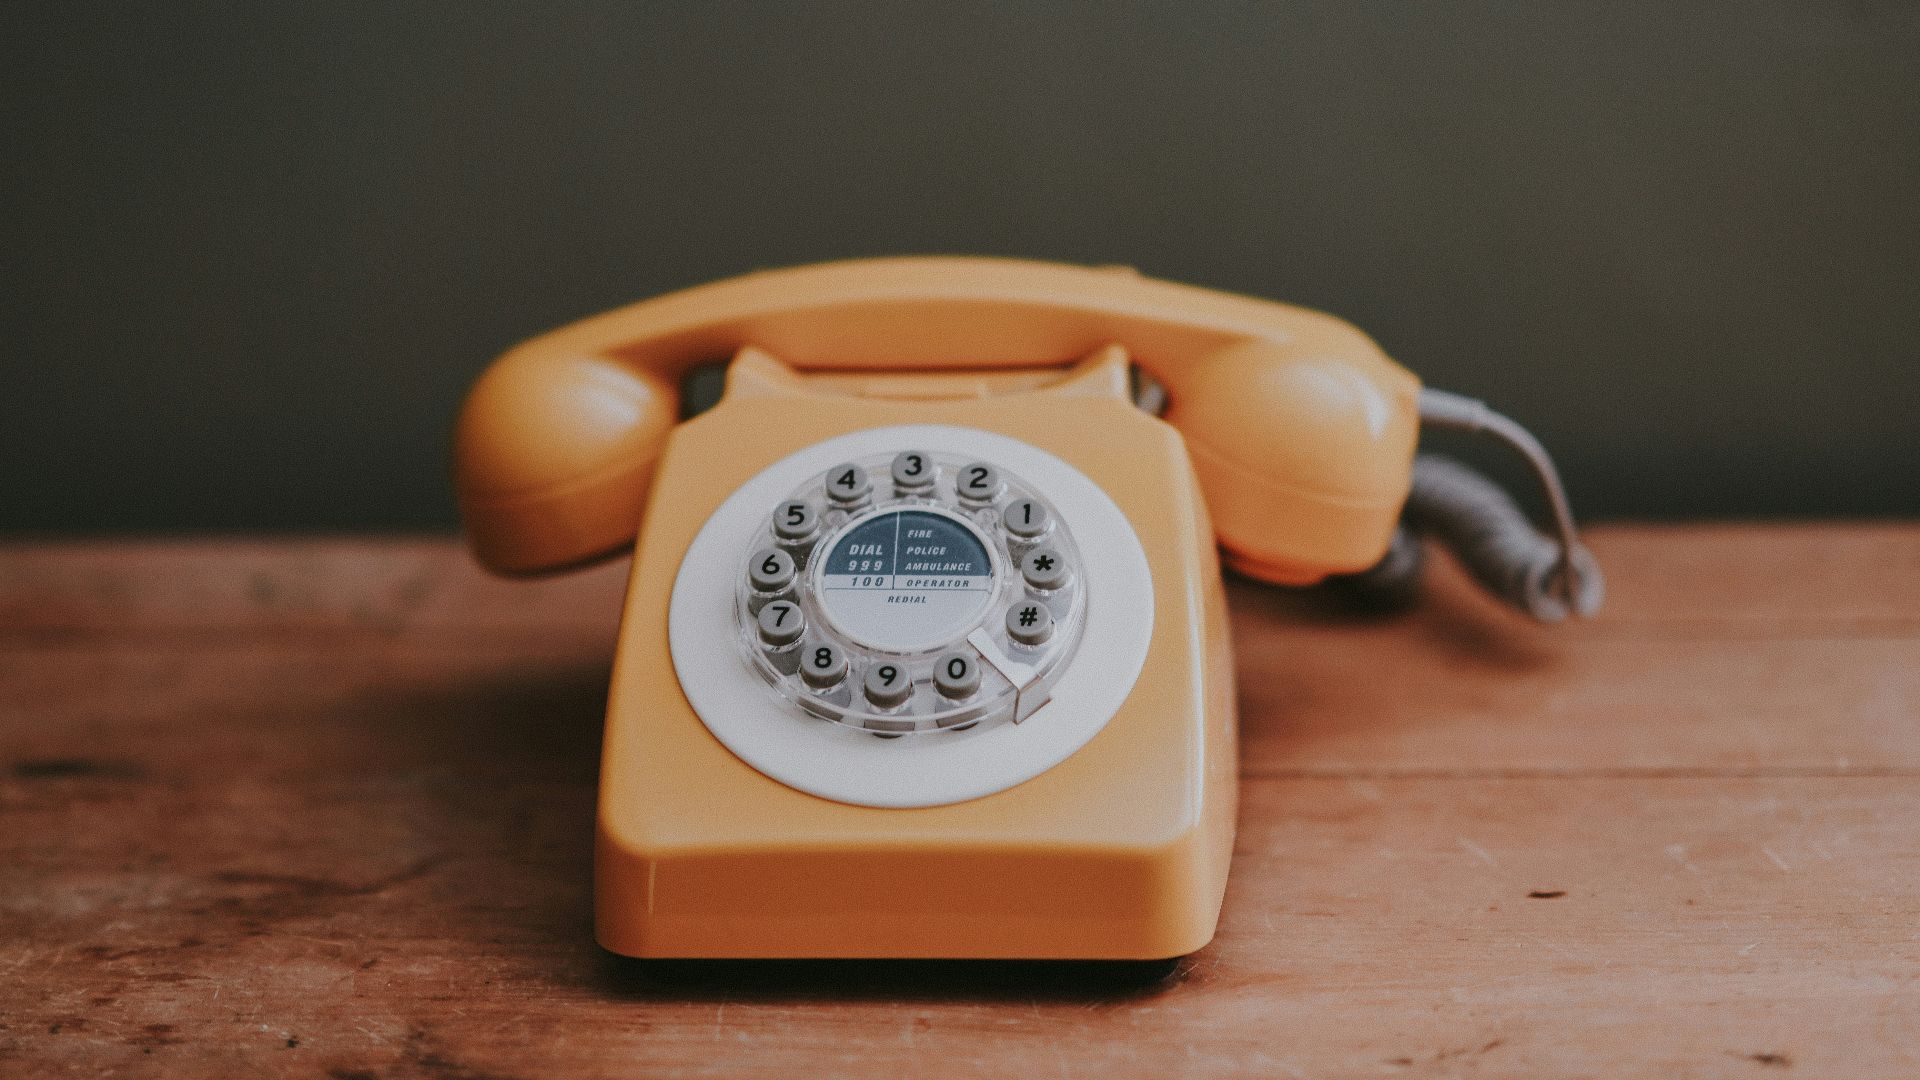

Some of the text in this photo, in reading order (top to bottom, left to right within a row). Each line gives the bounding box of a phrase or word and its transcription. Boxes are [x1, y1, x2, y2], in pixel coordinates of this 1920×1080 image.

[905, 455, 922, 476] 3
[837, 469, 855, 489] 4
[970, 468, 988, 488] 2
[787, 505, 804, 526] 5
[1023, 503, 1031, 525] 1
[907, 529, 933, 538] FIRE
[849, 544, 883, 555] DIAL
[906, 546, 947, 555] POLICE
[762, 554, 780, 575] 6
[905, 562, 971, 571] AMBULANCE
[906, 579, 969, 587] OPERATOR
[773, 606, 790, 627] 7
[1020, 607, 1037, 626] #
[814, 648, 832, 668] 8
[879, 666, 897, 686] 9
[948, 658, 966, 679] 0
